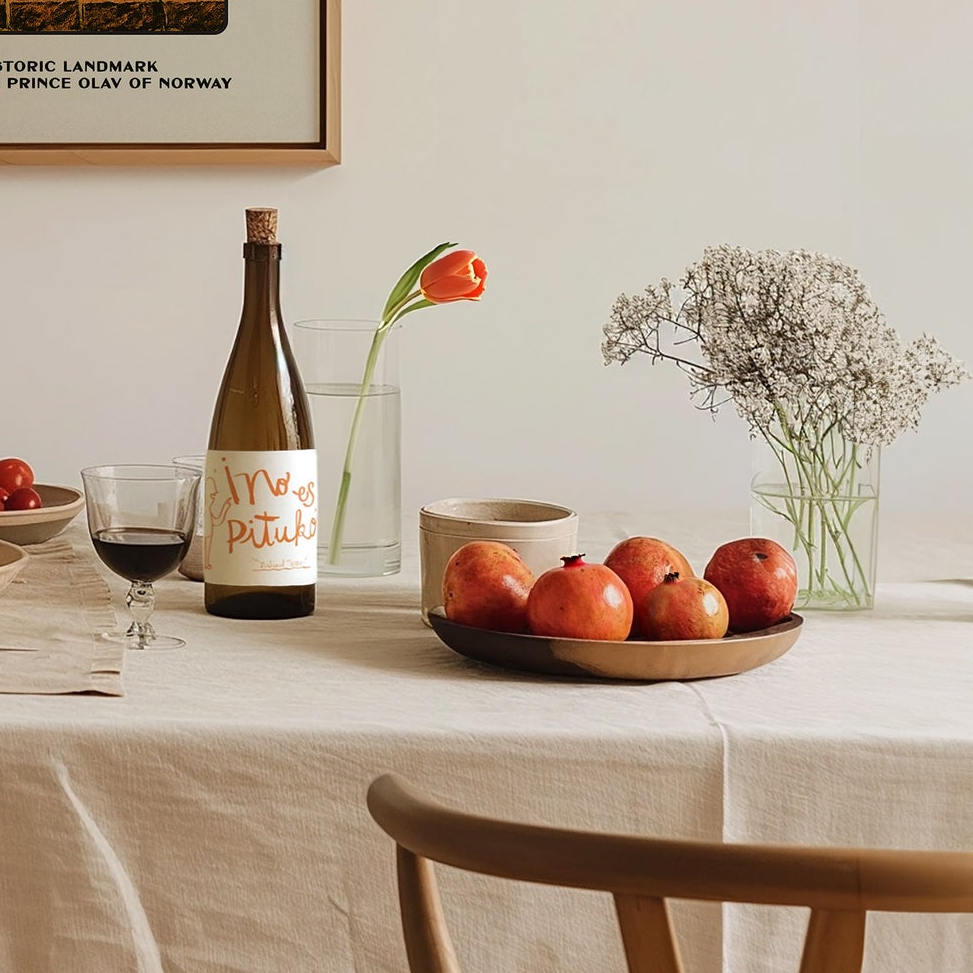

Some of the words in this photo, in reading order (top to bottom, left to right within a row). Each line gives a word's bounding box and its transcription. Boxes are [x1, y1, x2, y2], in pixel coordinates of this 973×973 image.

[63, 60, 159, 73] LANDMARK
[7, 77, 72, 90] PRINCE
[78, 77, 122, 90] OLAV
[128, 77, 152, 90] OF
[159, 77, 233, 90] NORWAY
